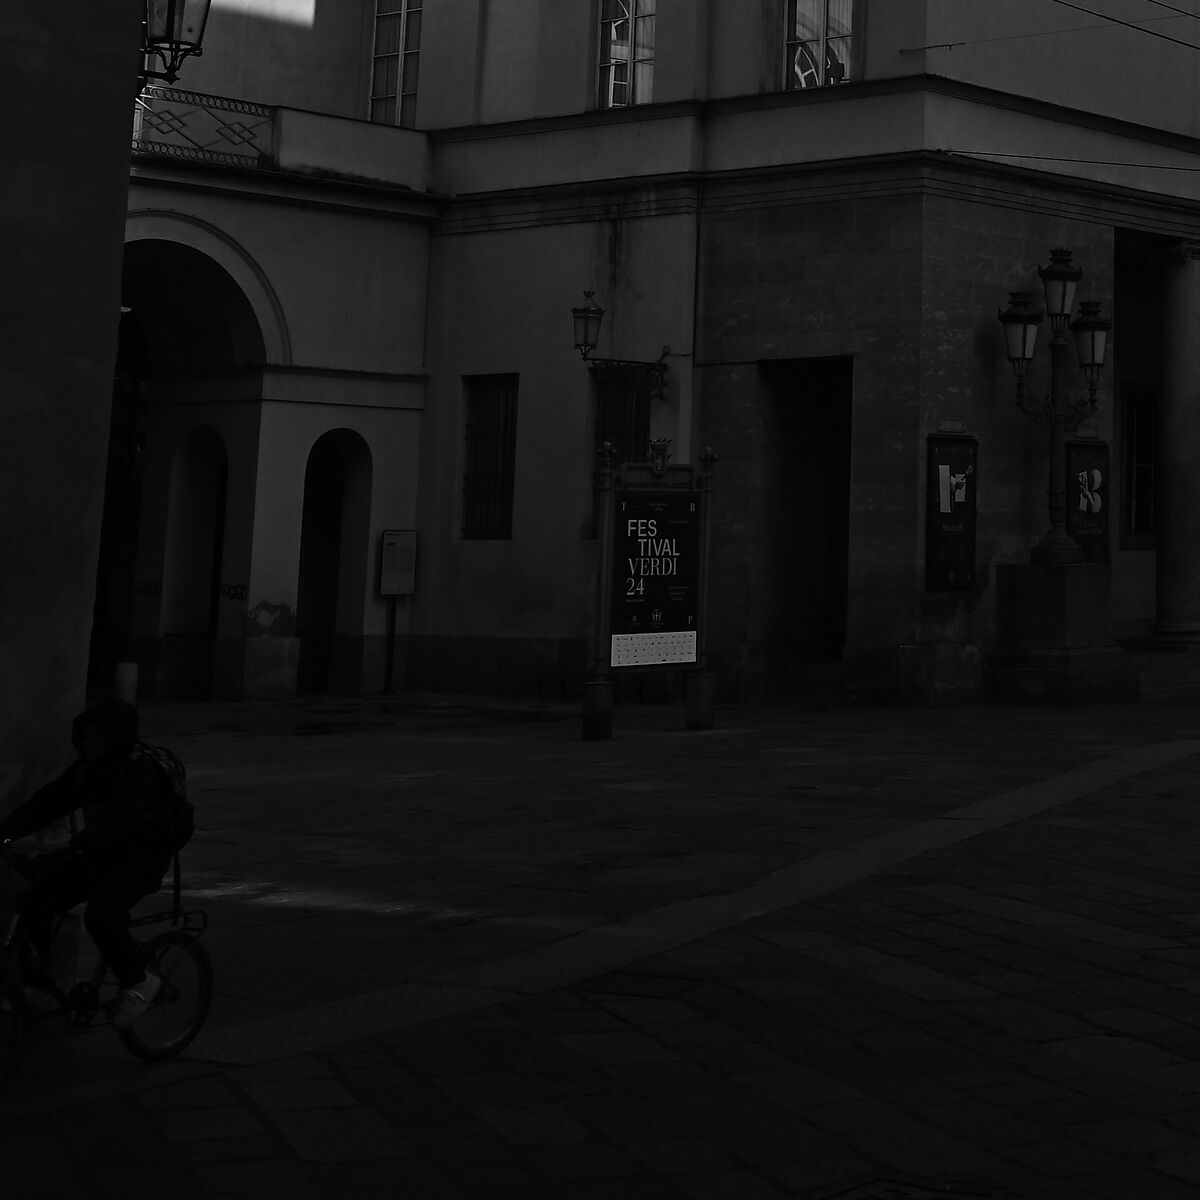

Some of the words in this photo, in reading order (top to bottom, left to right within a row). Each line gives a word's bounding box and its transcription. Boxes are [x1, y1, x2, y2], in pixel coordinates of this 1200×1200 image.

[627, 519, 657, 537] FES
[637, 538, 680, 557] TIVAL
[628, 558, 677, 576] VERDI
[626, 577, 645, 596] 24
